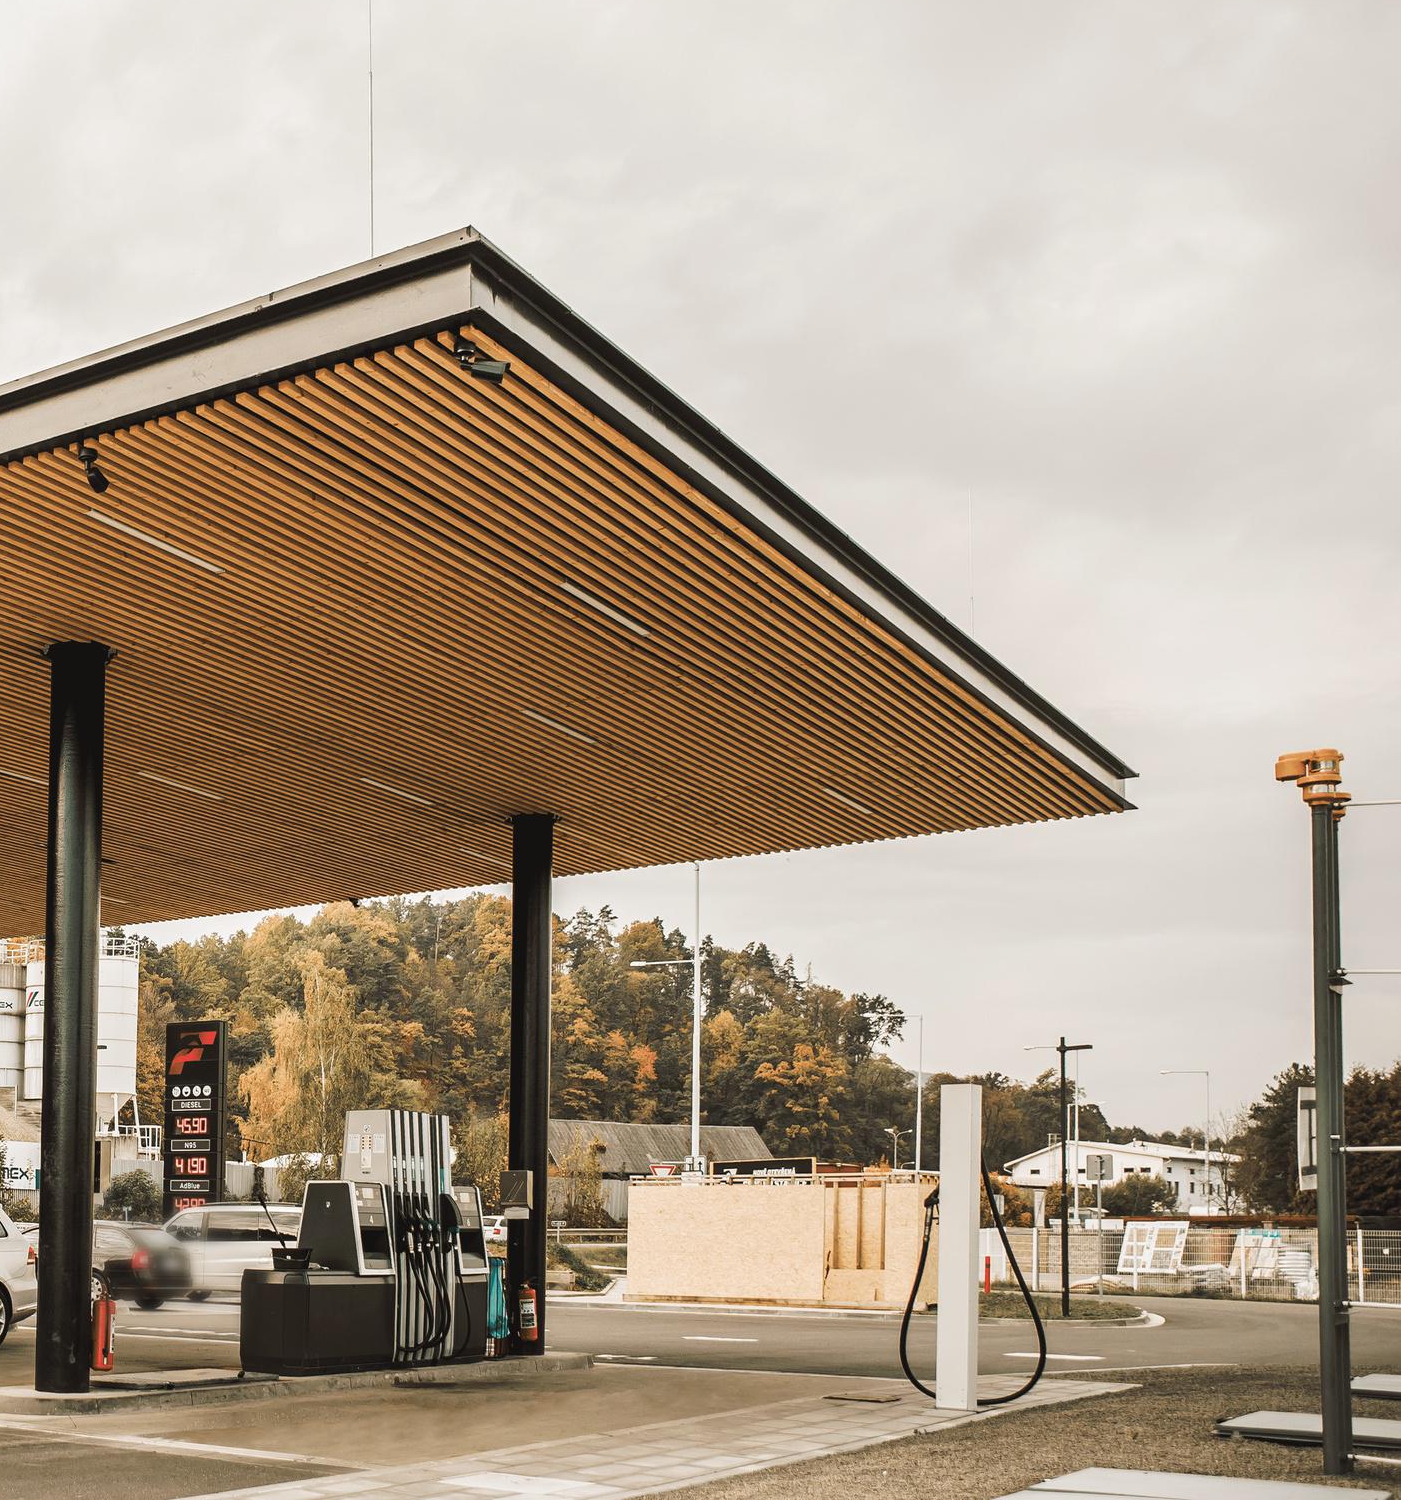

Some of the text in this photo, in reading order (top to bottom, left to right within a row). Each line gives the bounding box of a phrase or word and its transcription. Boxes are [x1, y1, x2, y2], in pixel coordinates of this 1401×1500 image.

[180, 1101, 202, 1109] DIESEL
[176, 1118, 207, 1134] 45.90
[184, 1141, 197, 1149] N95
[0, 1167, 29, 1180] MEX
[179, 1182, 201, 1190] AdBlue
[369, 1215, 374, 1224] 4
